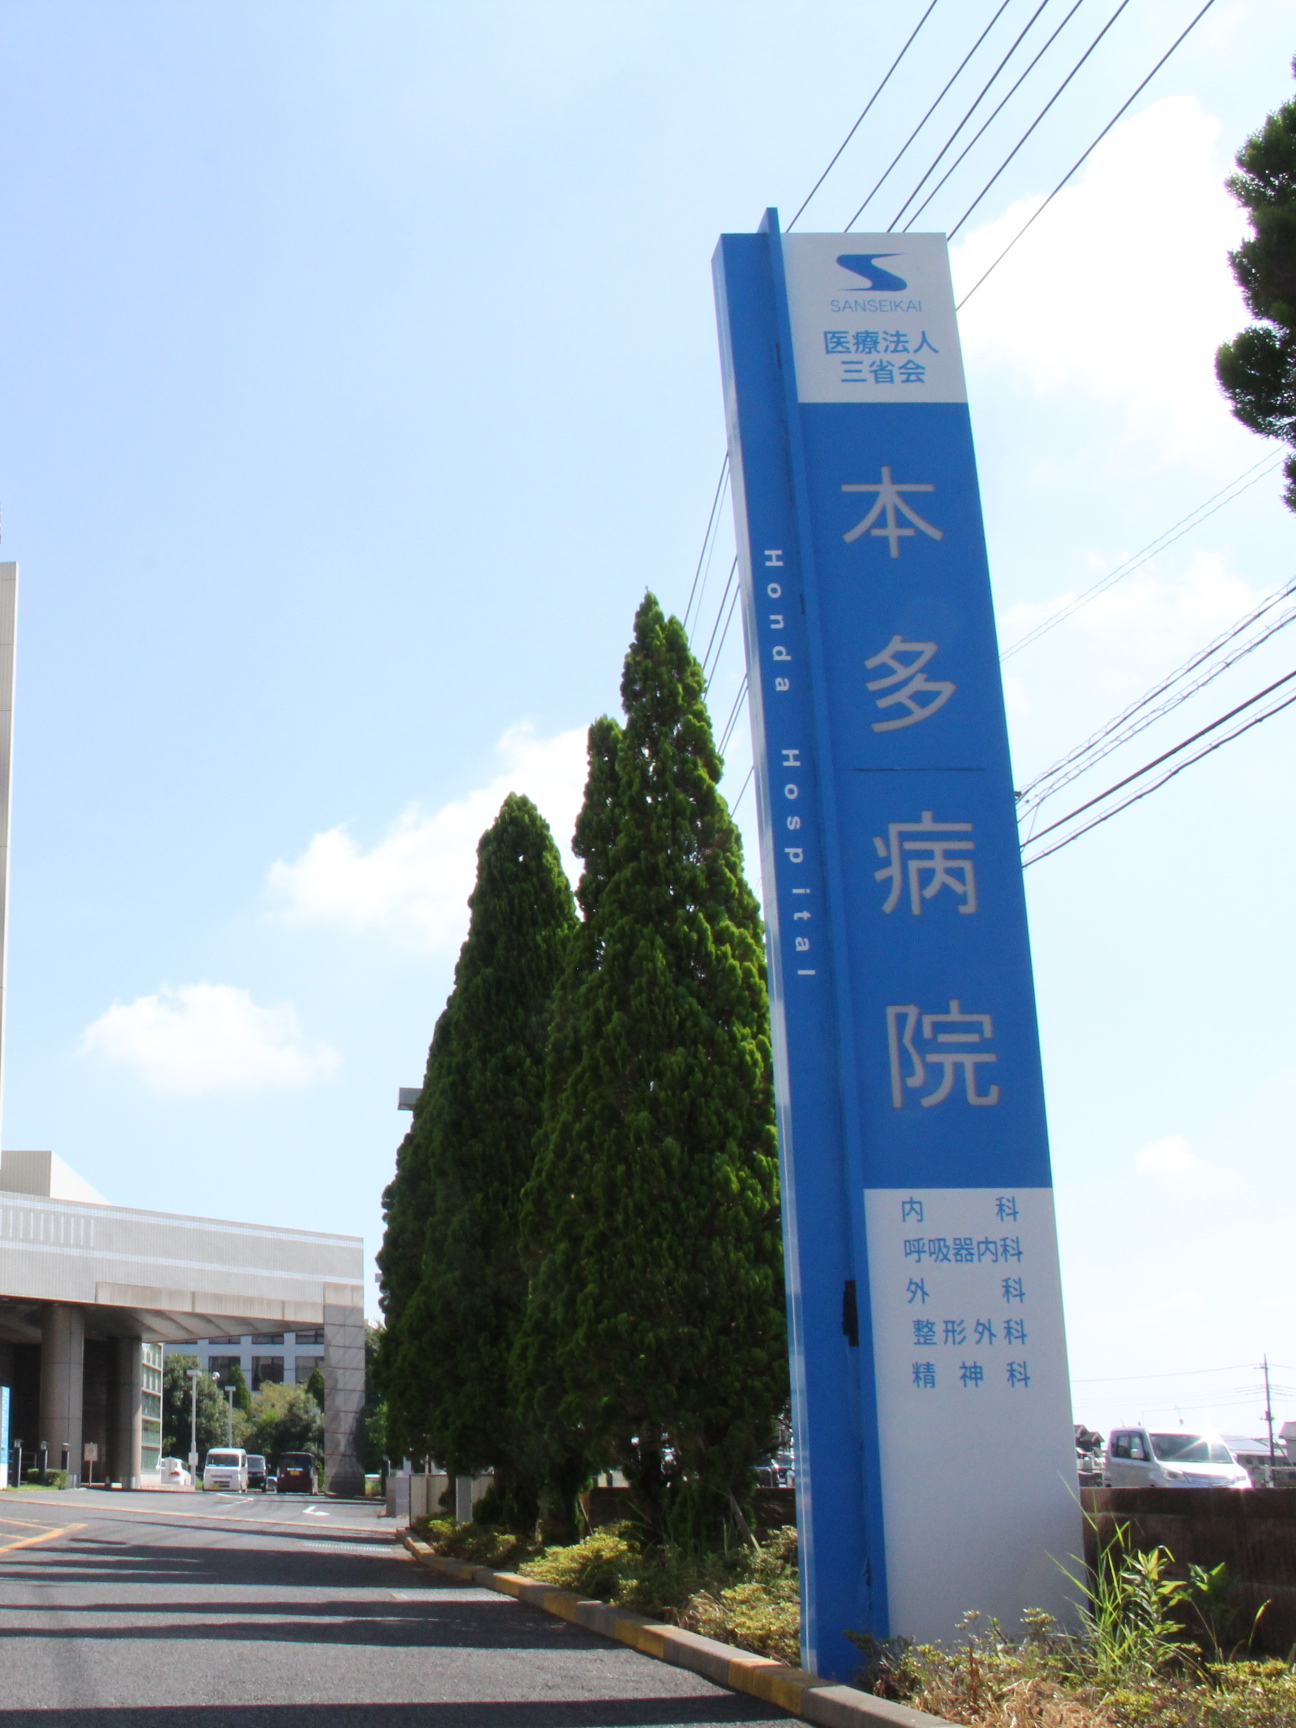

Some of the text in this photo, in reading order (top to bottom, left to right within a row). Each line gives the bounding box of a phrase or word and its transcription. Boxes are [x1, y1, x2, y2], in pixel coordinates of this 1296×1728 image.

[830, 299, 923, 313] SANSEIKAI
[823, 330, 940, 355] 医療法人
[840, 359, 927, 384] 三省会
[764, 549, 816, 976] Honda Hospital
[841, 465, 1000, 1109] 本多病院
[904, 1236, 1024, 1264] 呼吸器内科
[912, 1318, 1028, 1346] 整形外科
[912, 1361, 1031, 1389] 精神科
